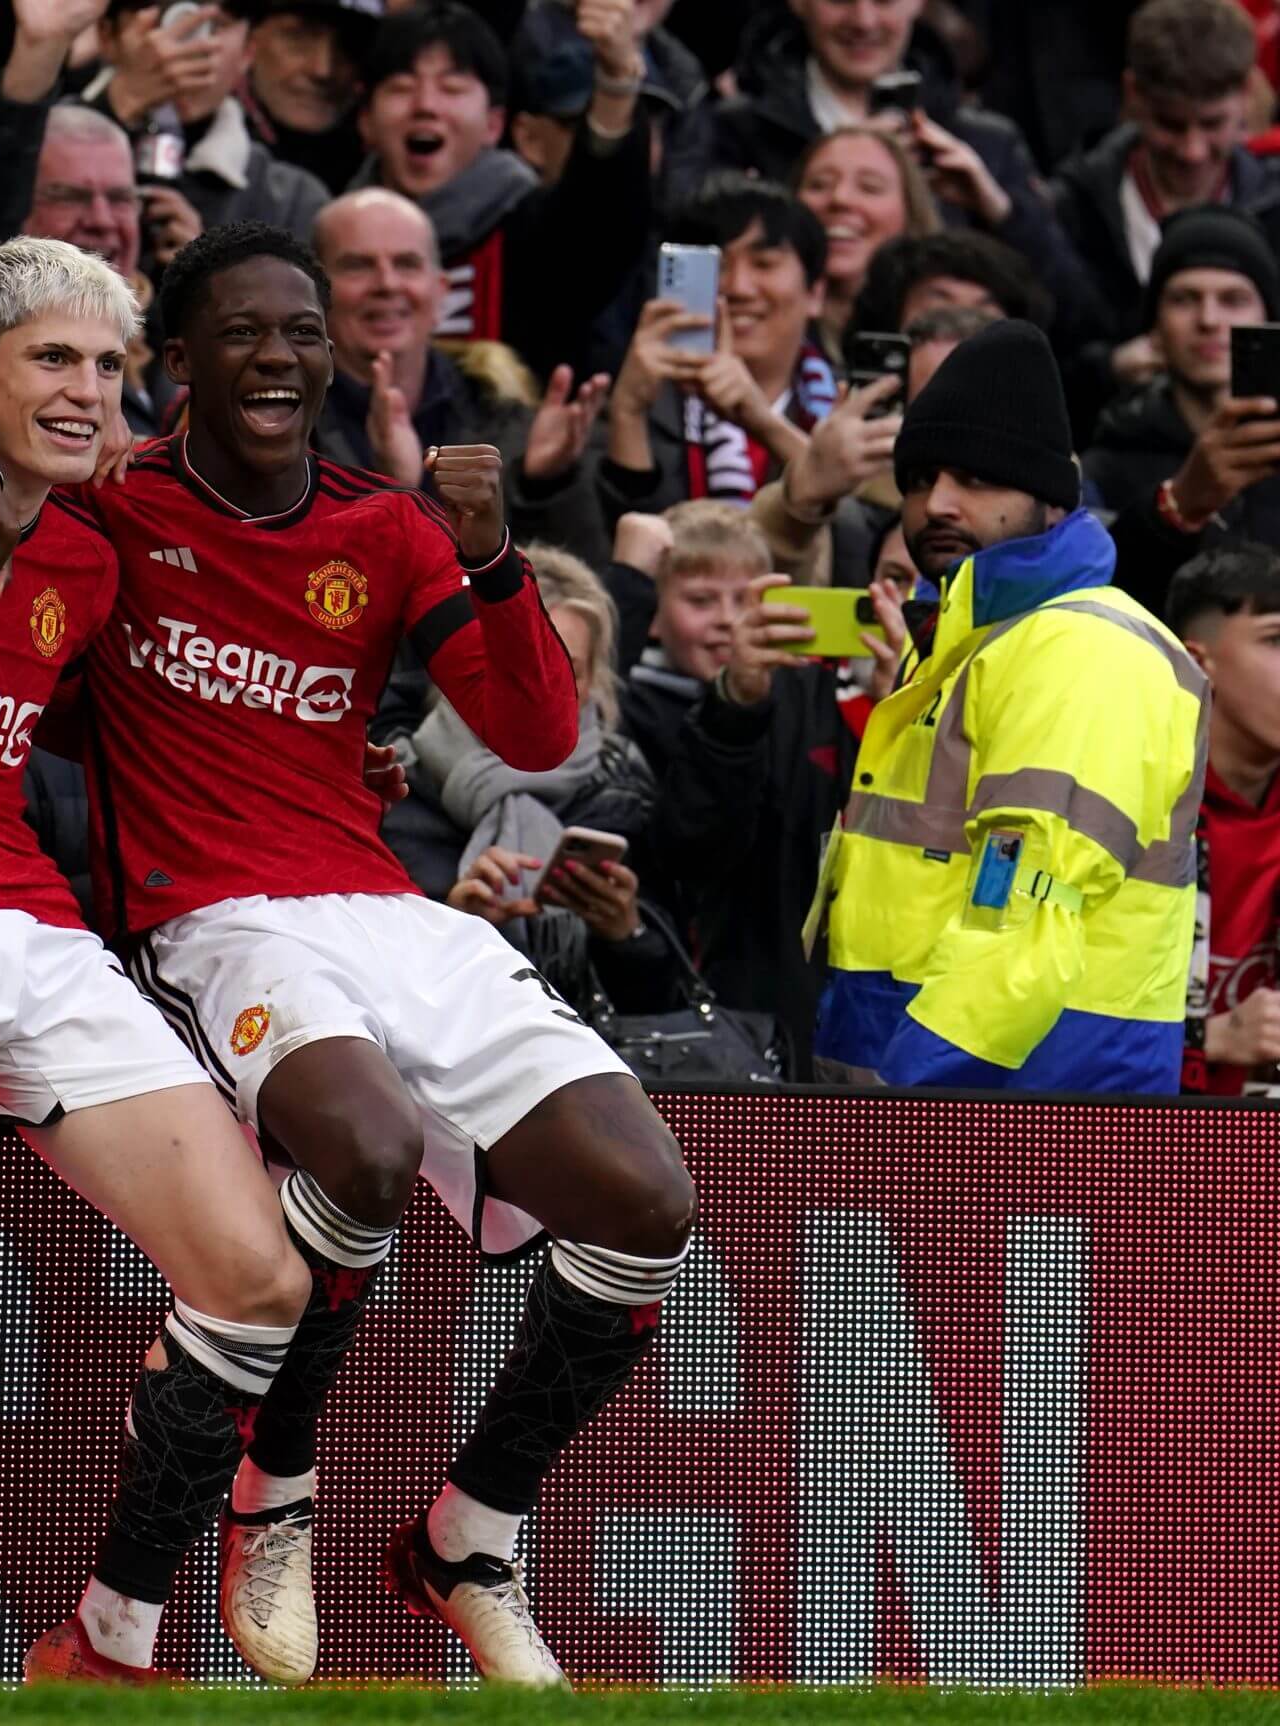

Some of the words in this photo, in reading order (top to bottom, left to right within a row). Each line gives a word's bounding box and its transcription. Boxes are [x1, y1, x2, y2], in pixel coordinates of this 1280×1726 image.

[312, 565, 363, 588] MANCHESTER
[318, 612, 353, 625] UNITED
[122, 623, 297, 715] Viewer
[158, 616, 297, 690] Team
